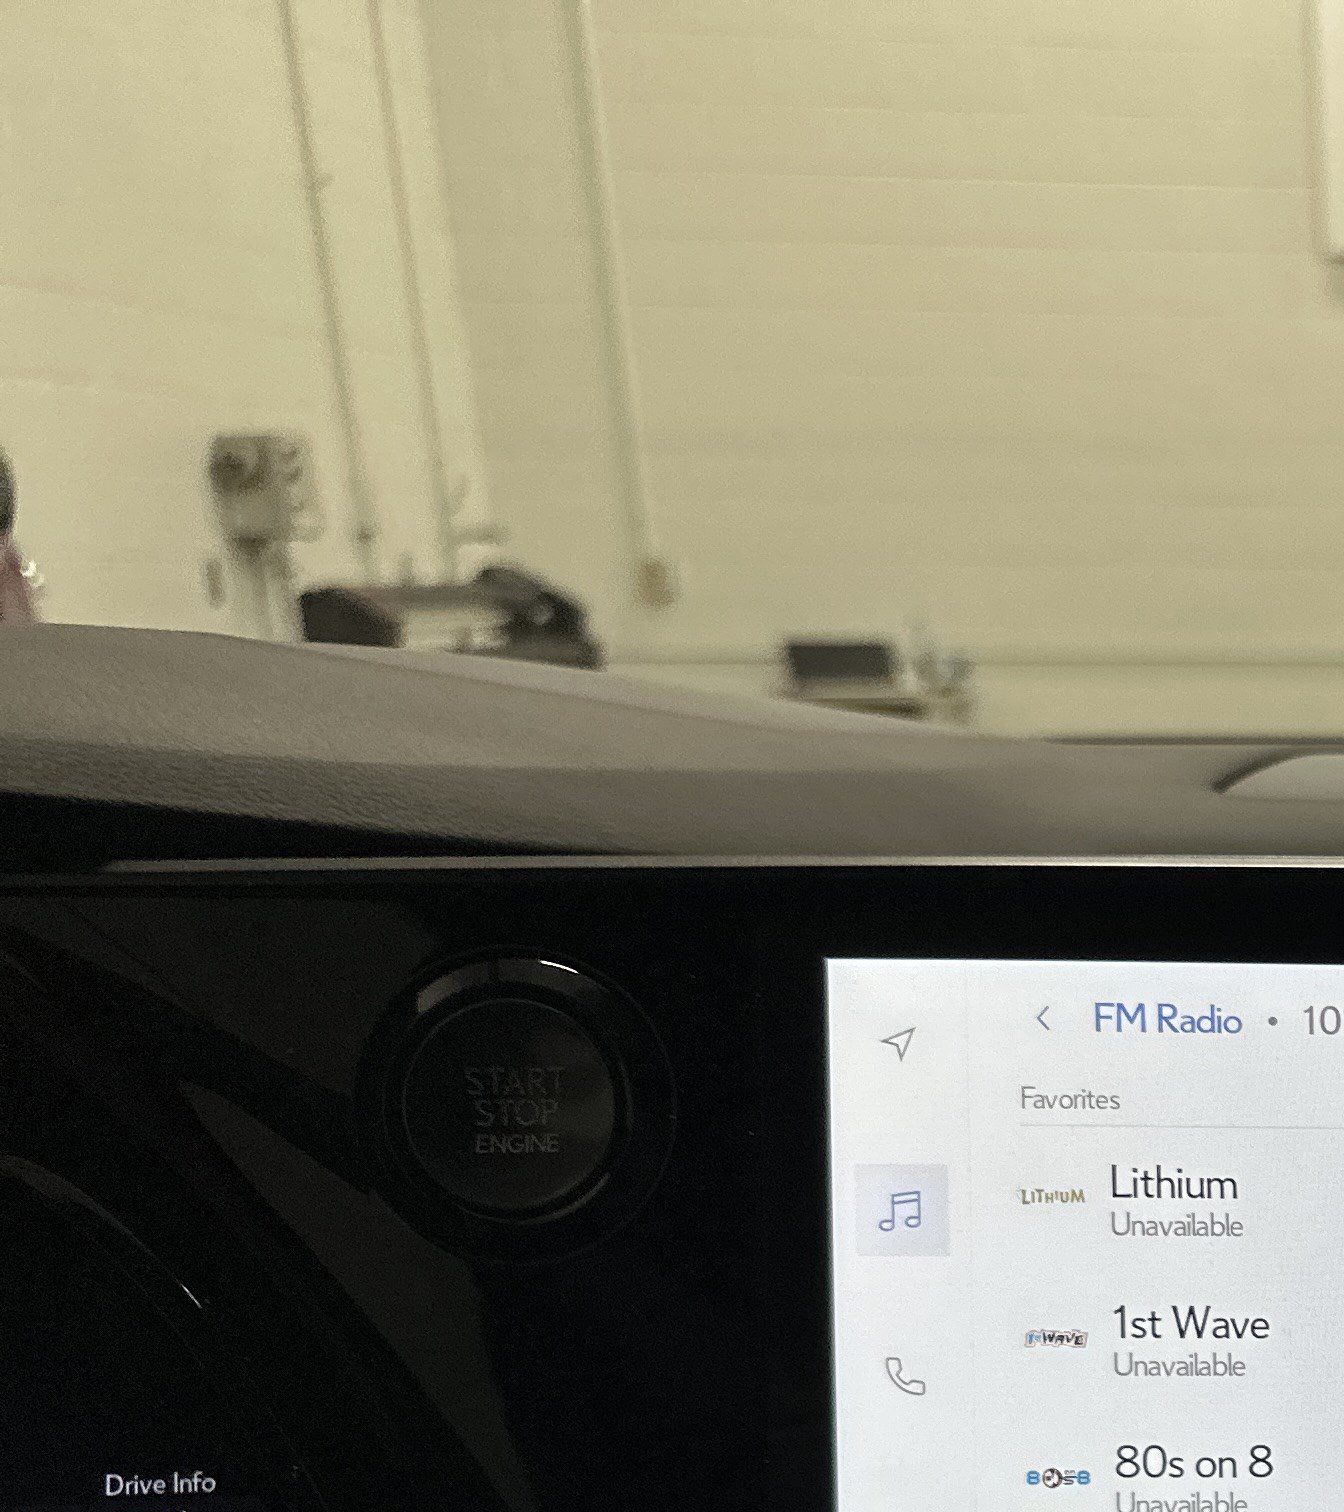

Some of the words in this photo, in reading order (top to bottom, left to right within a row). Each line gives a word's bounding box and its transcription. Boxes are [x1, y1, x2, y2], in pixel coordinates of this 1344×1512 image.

[1094, 1001, 1147, 1033] FM
[1156, 1002, 1243, 1035] Radio
[464, 1066, 565, 1096] START
[1020, 1085, 1121, 1111] Favorites
[473, 1099, 560, 1126] STOP
[475, 1133, 560, 1153] ENGINE
[1110, 1163, 1239, 1200] Lithium
[1110, 1211, 1244, 1238] Unavailable
[1113, 1304, 1162, 1340] 1st
[1171, 1304, 1270, 1340] Wave
[1112, 1351, 1247, 1378] Unavailable
[1115, 1444, 1185, 1479] 80s
[1194, 1456, 1238, 1479] on
[1248, 1444, 1274, 1479] 8
[105, 1473, 167, 1497] Drive
[173, 1470, 217, 1494] Info
